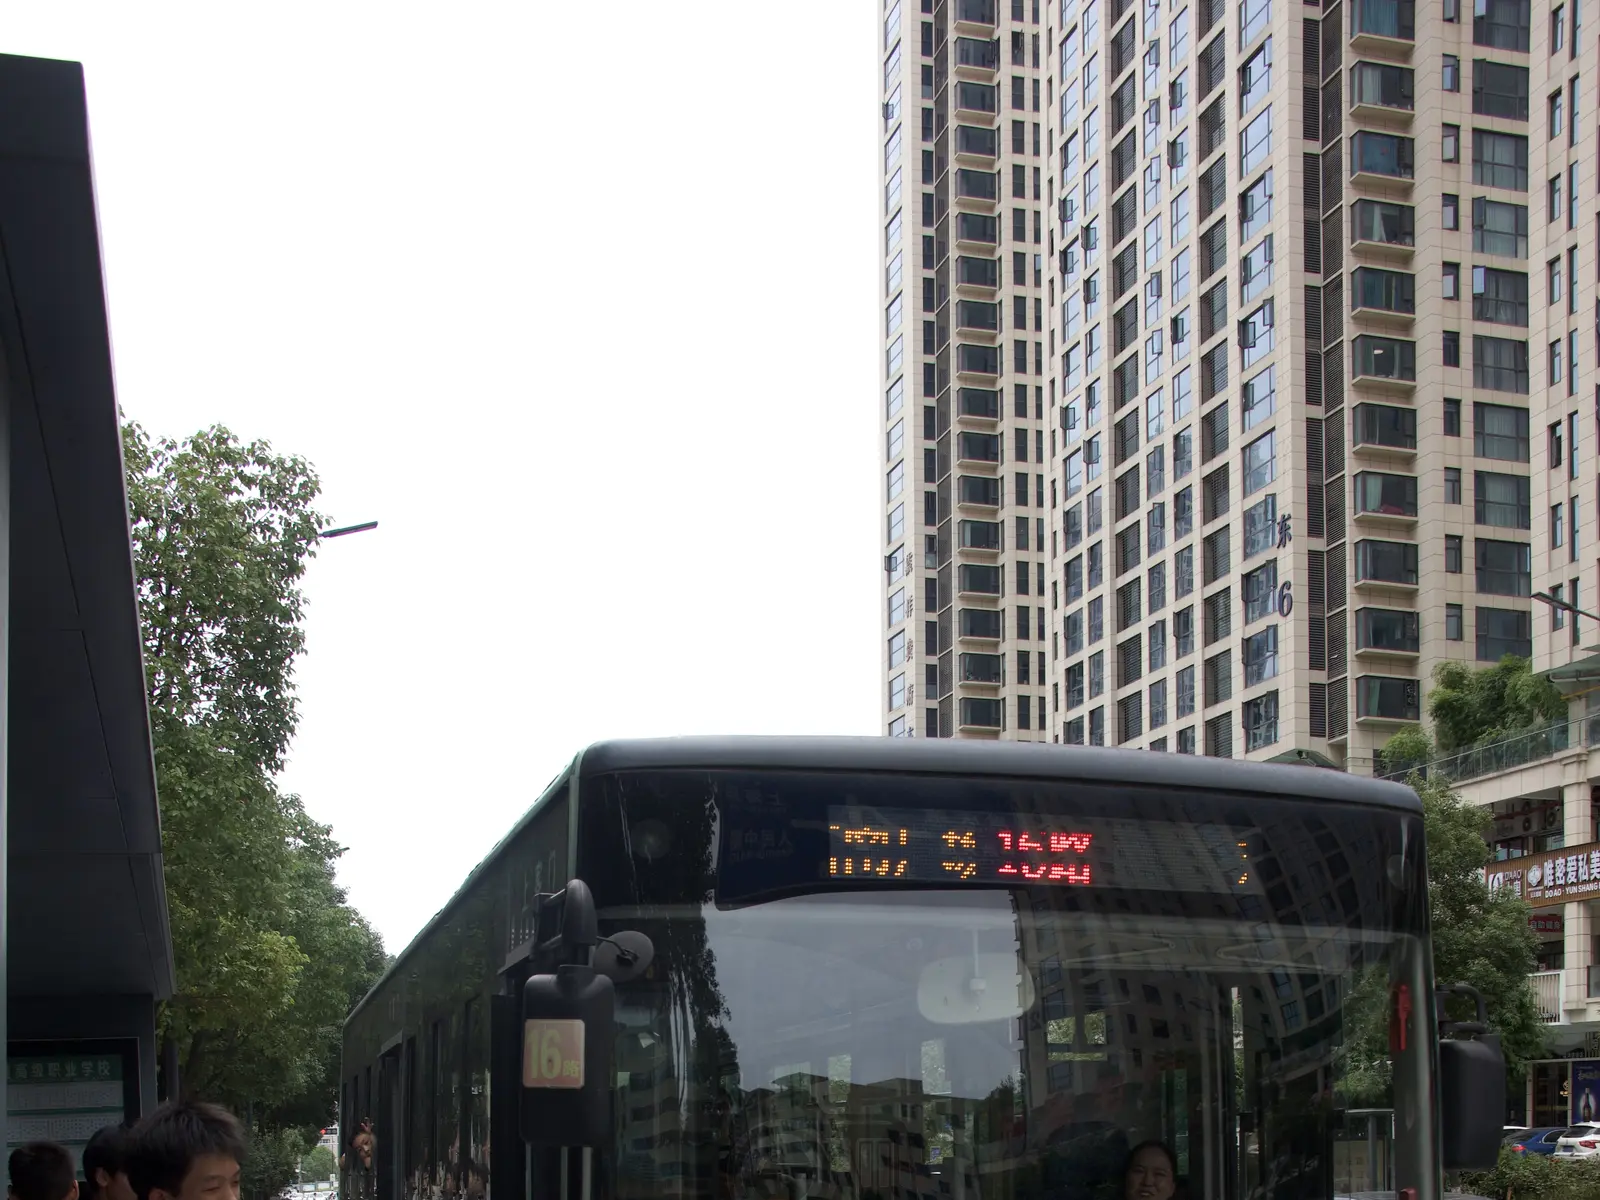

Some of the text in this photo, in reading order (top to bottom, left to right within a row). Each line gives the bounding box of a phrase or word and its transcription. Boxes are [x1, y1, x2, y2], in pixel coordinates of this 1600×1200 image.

[7, 1059, 111, 1080] 高级职业学校
